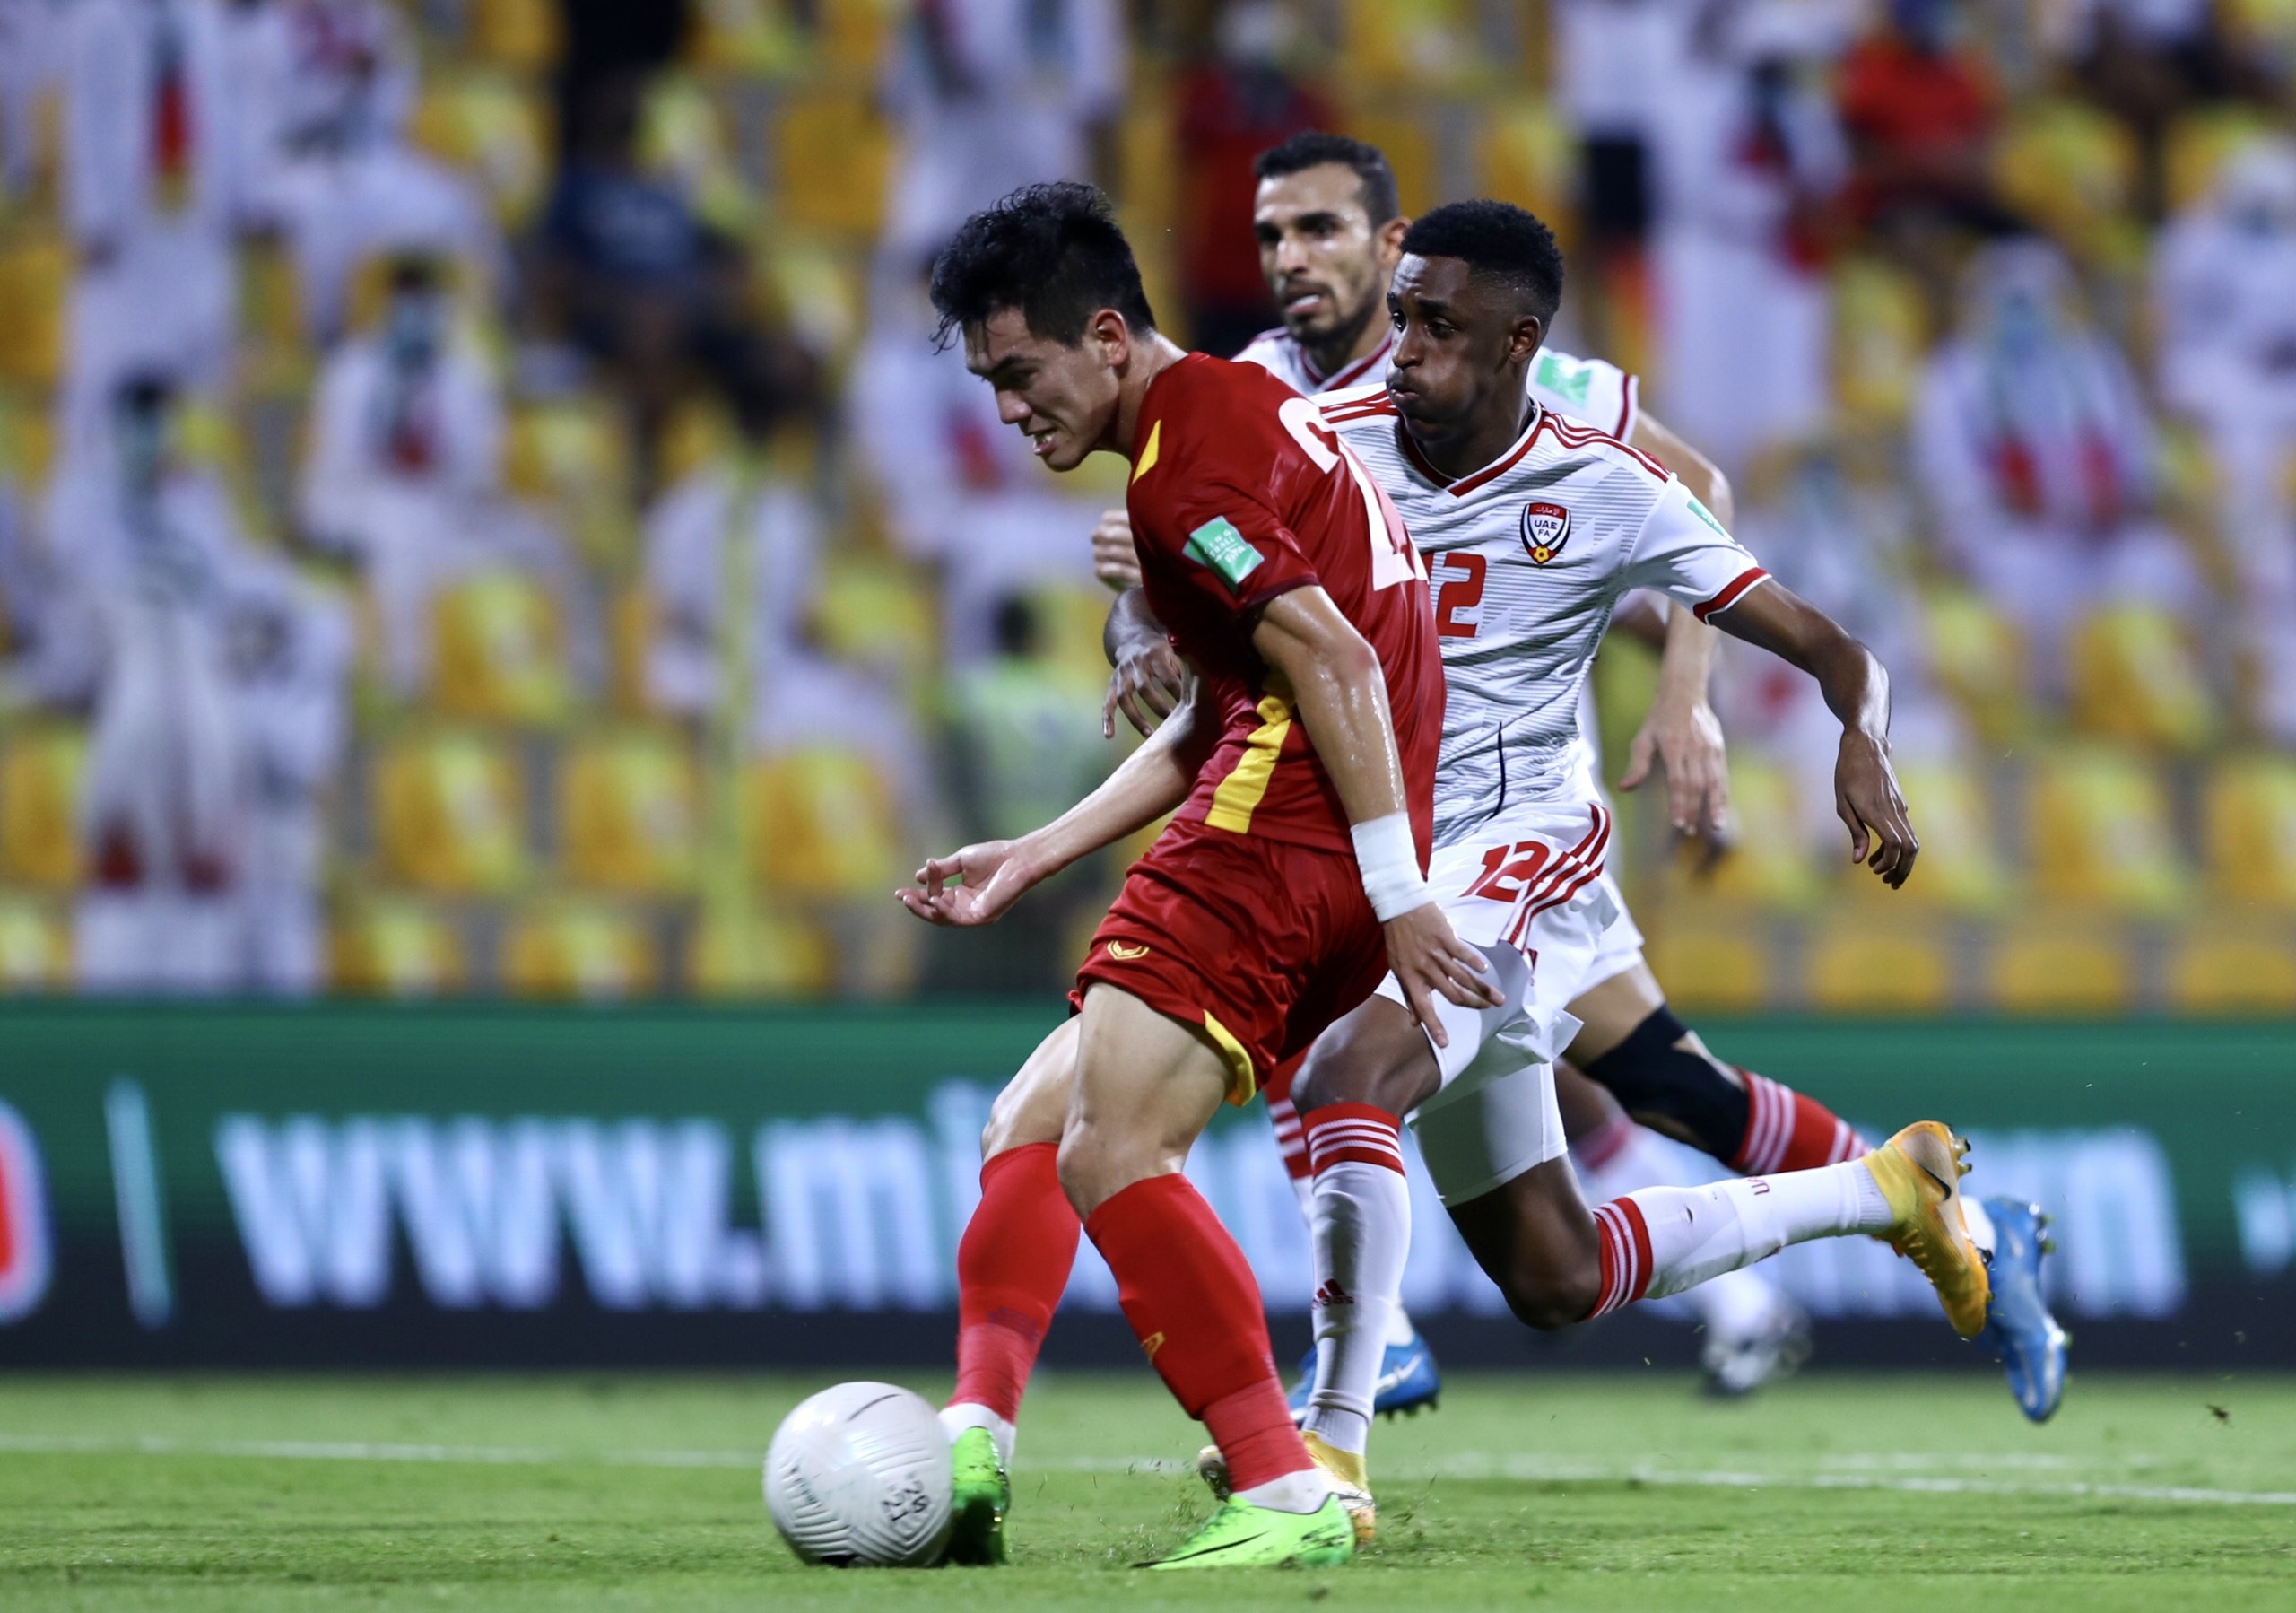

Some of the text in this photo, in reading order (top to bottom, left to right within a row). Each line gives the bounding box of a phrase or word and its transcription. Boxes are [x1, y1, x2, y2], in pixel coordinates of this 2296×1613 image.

[1534, 519, 1558, 530] UAE
[1538, 528, 1551, 537] FA
[1458, 841, 1550, 903] 12
